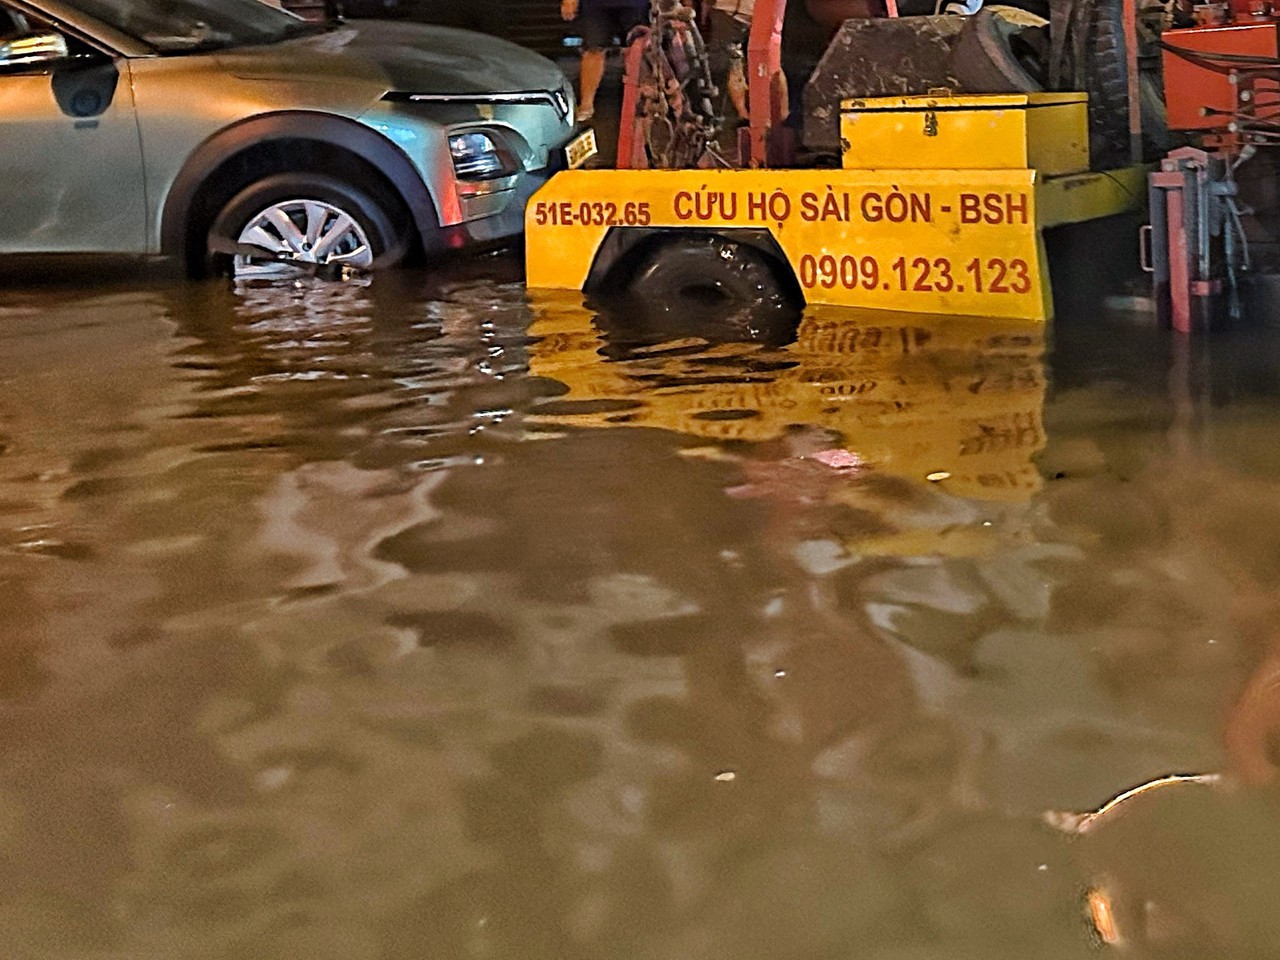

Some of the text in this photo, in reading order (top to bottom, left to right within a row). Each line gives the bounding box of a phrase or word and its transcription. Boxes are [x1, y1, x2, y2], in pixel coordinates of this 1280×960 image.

[535, 202, 651, 227] 51E-032.65
[673, 184, 738, 221] CỨU
[748, 189, 791, 229] HỘ
[800, 186, 850, 223] SÀI
[860, 185, 931, 224] GÒN
[960, 193, 1028, 225] BSH
[800, 254, 1031, 294] 0909.123.123
